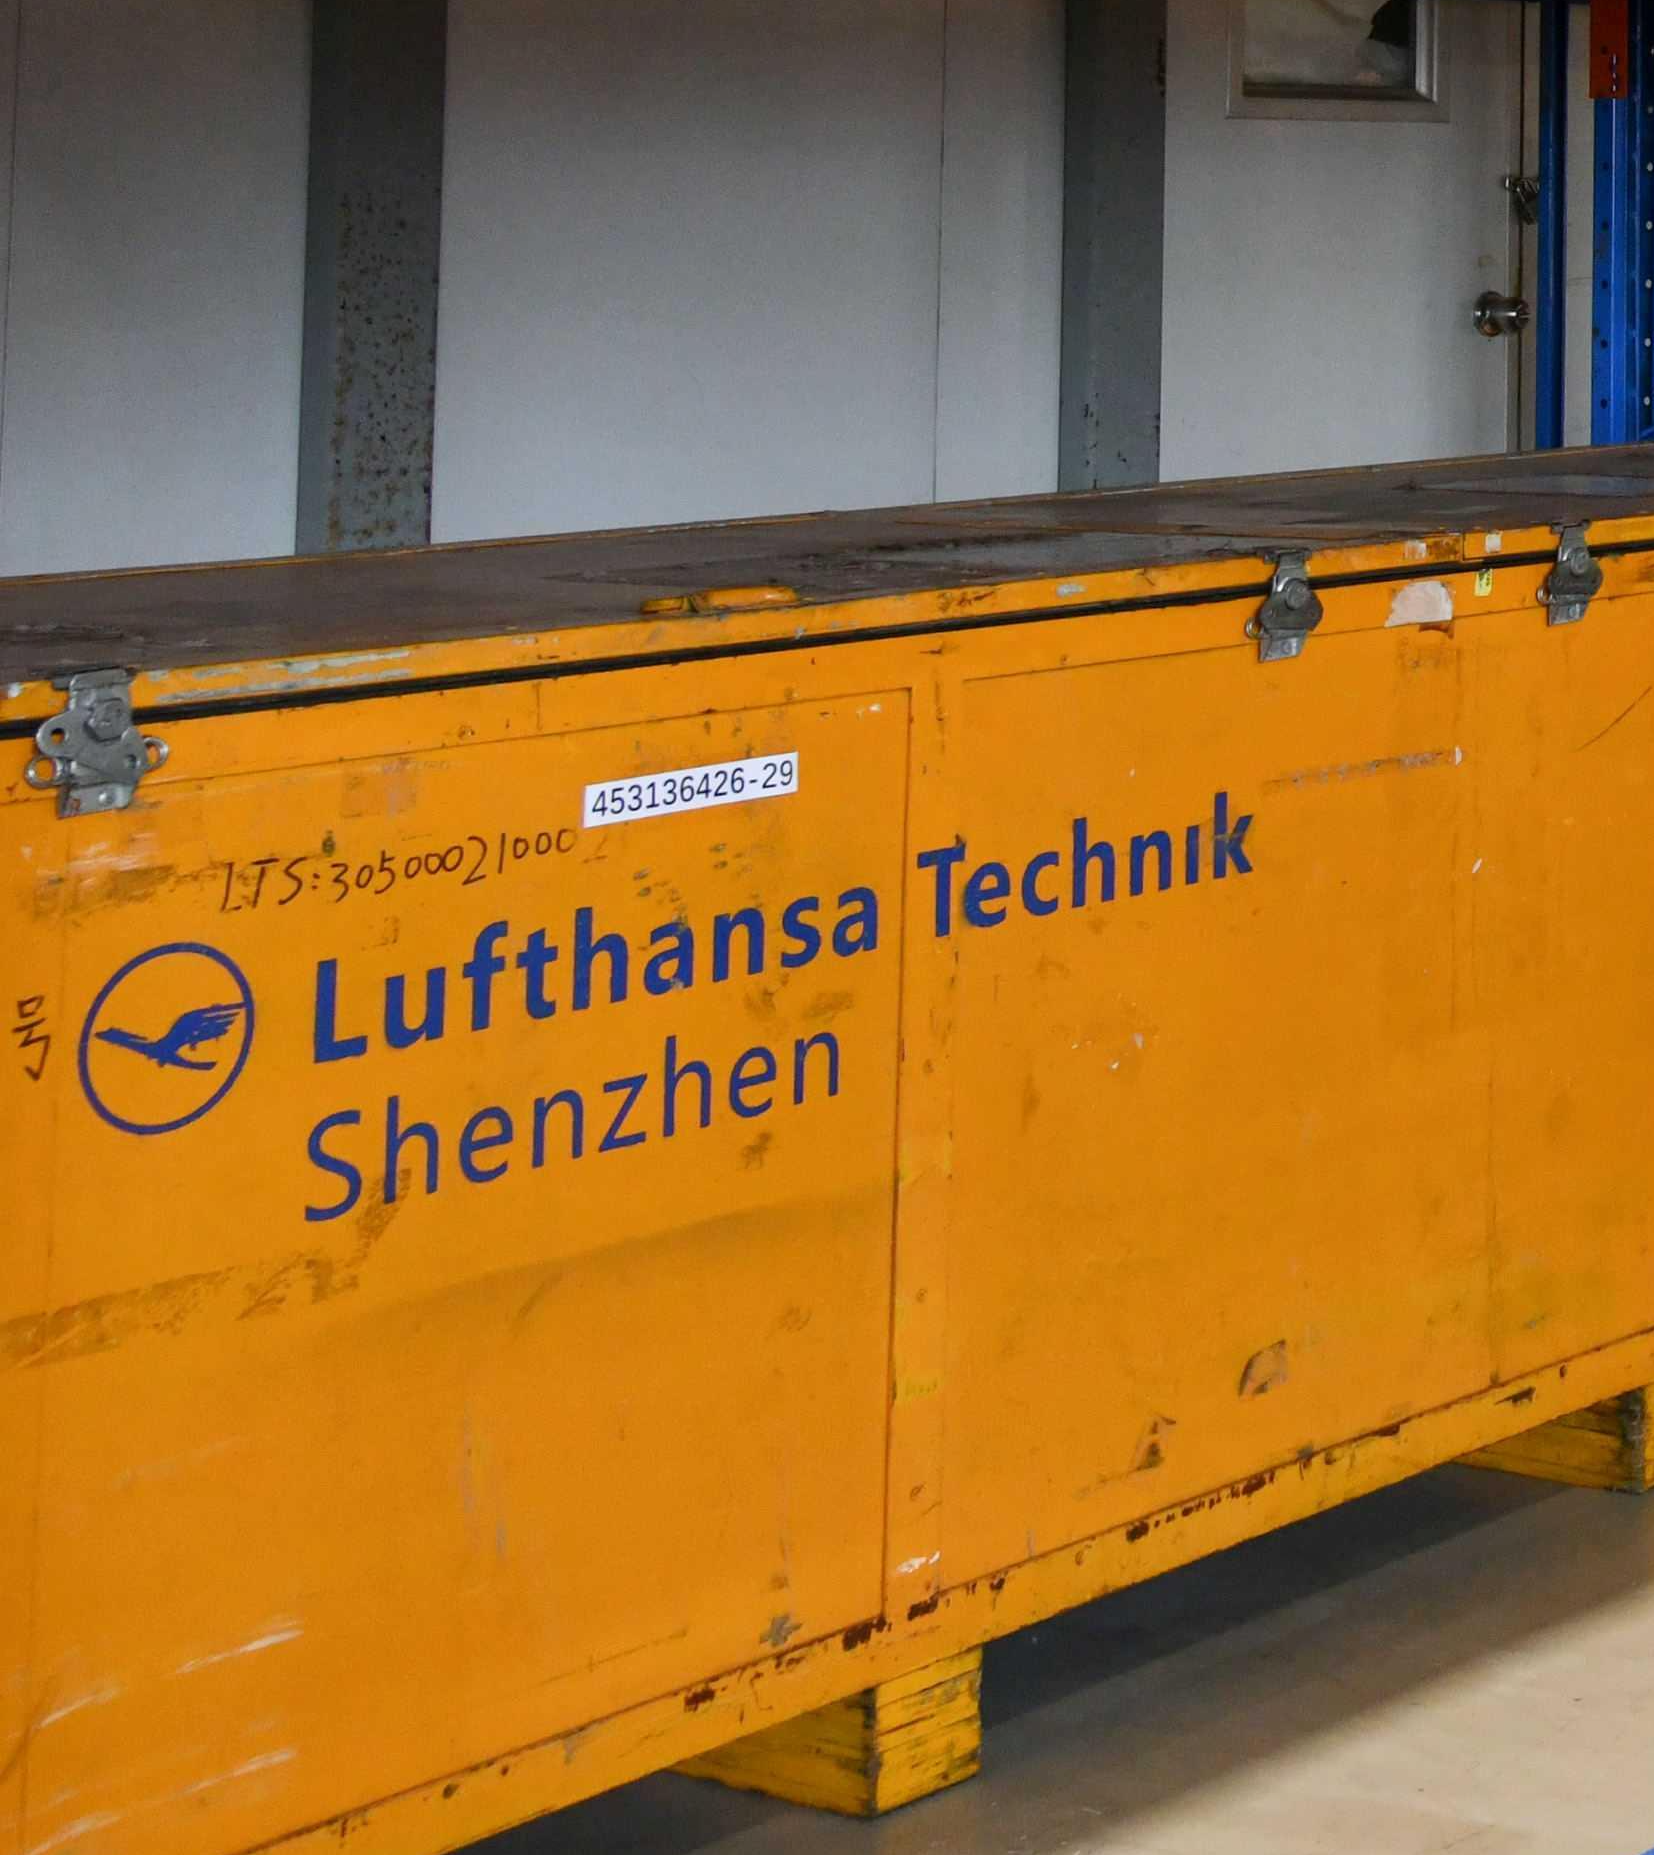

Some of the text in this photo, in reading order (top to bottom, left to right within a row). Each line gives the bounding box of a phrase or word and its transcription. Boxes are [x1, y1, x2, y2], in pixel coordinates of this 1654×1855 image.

[591, 760, 794, 818] 453136426-29
[313, 791, 1254, 1064] Lufthansa Technik
[304, 1030, 841, 1224] Shenzhen
